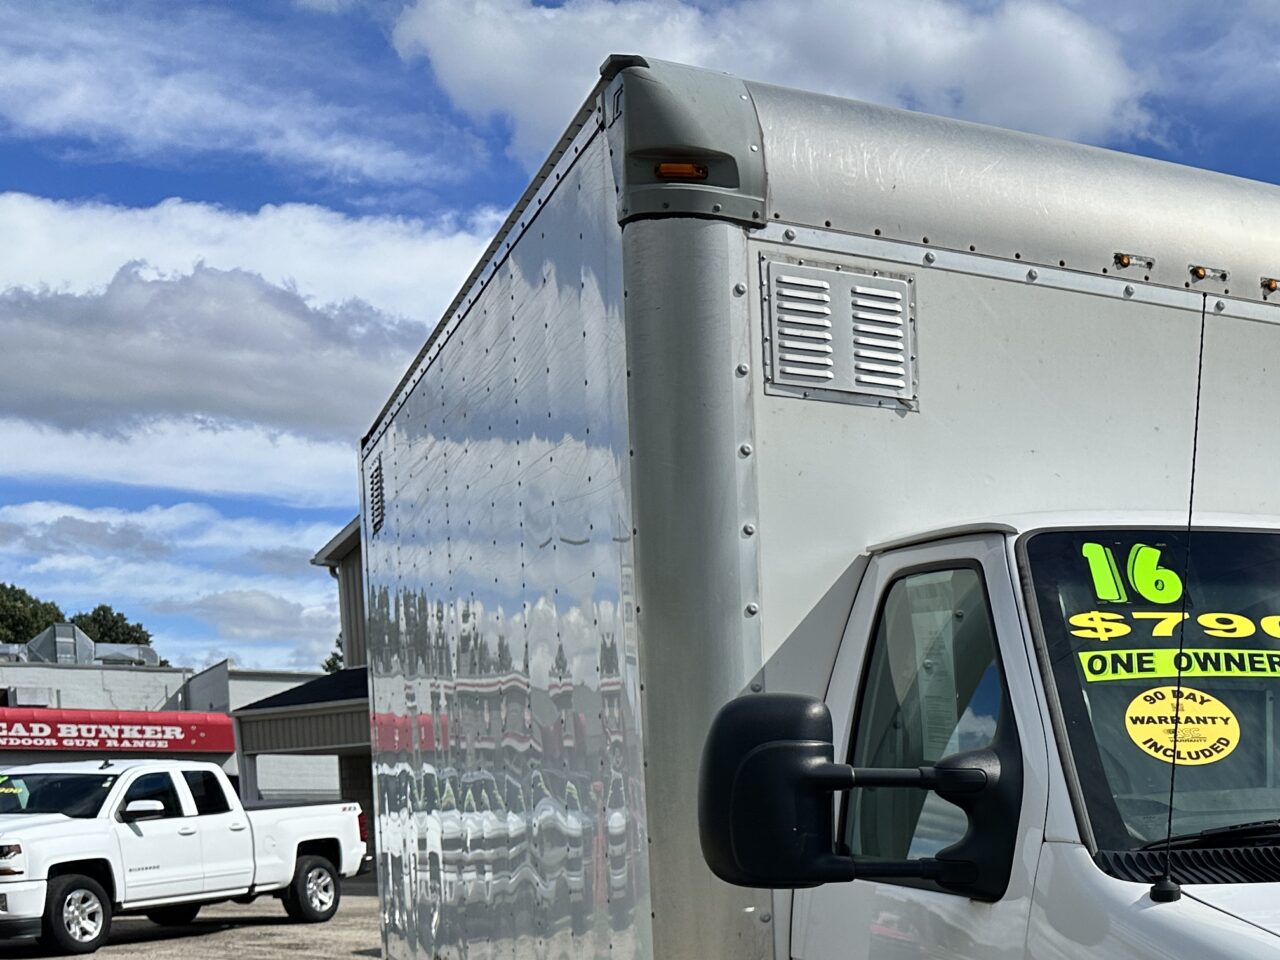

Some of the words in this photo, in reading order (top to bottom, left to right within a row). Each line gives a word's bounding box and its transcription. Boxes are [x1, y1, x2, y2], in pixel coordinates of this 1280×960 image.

[1082, 542, 1183, 604] 16
[1087, 652, 1155, 676] ONE
[1143, 691, 1166, 704] 90
[1171, 689, 1212, 706] DAY
[1129, 716, 1231, 725] WARRANTY
[57, 724, 185, 739] BUNKER
[62, 739, 100, 747] GUN
[106, 739, 169, 748] RANGE
[1142, 737, 1231, 760] INCLUDED
